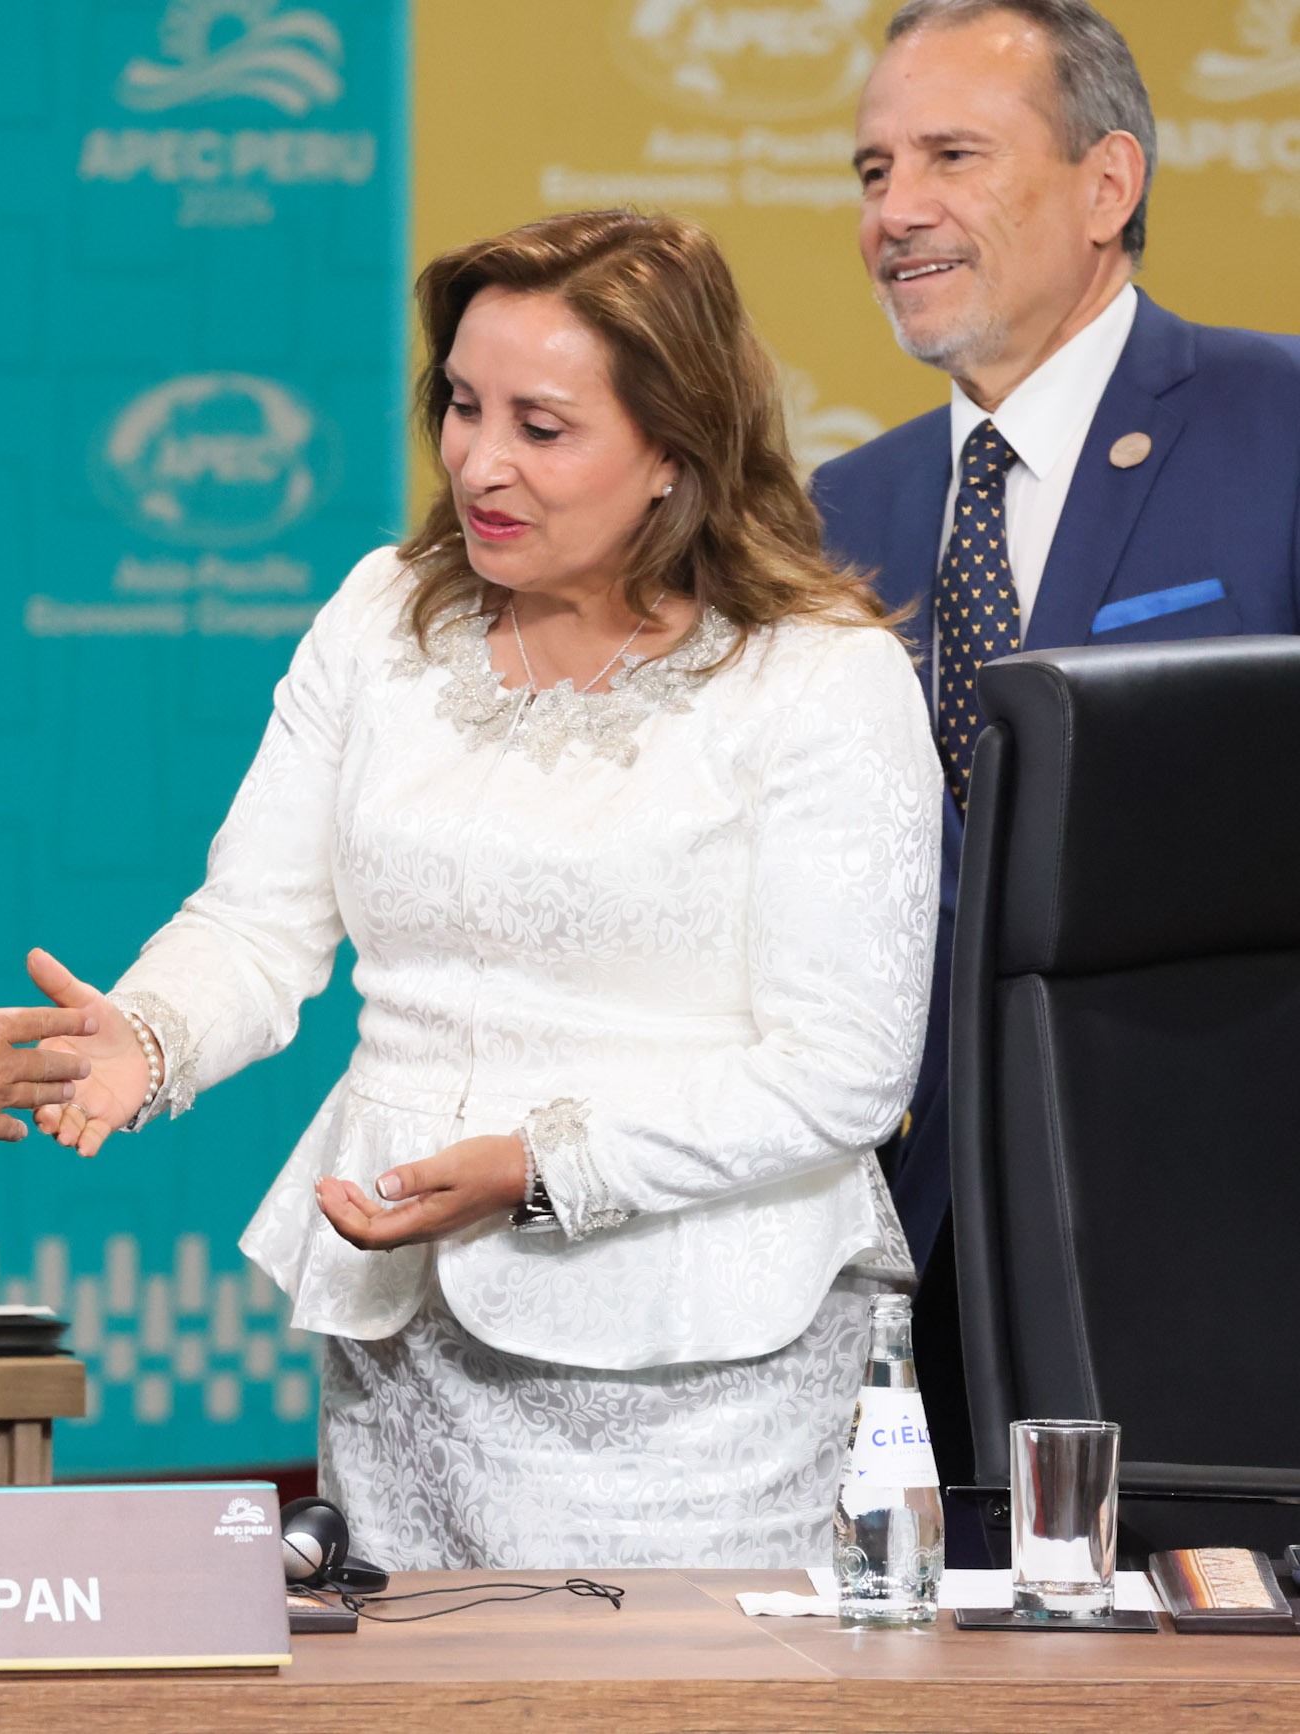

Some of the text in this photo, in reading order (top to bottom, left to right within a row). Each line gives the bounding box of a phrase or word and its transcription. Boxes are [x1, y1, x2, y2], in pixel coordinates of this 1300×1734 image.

[79, 129, 376, 184] APEC PERU
[156, 434, 280, 483] APEC
[214, 1526, 273, 1536] APEC PERU
